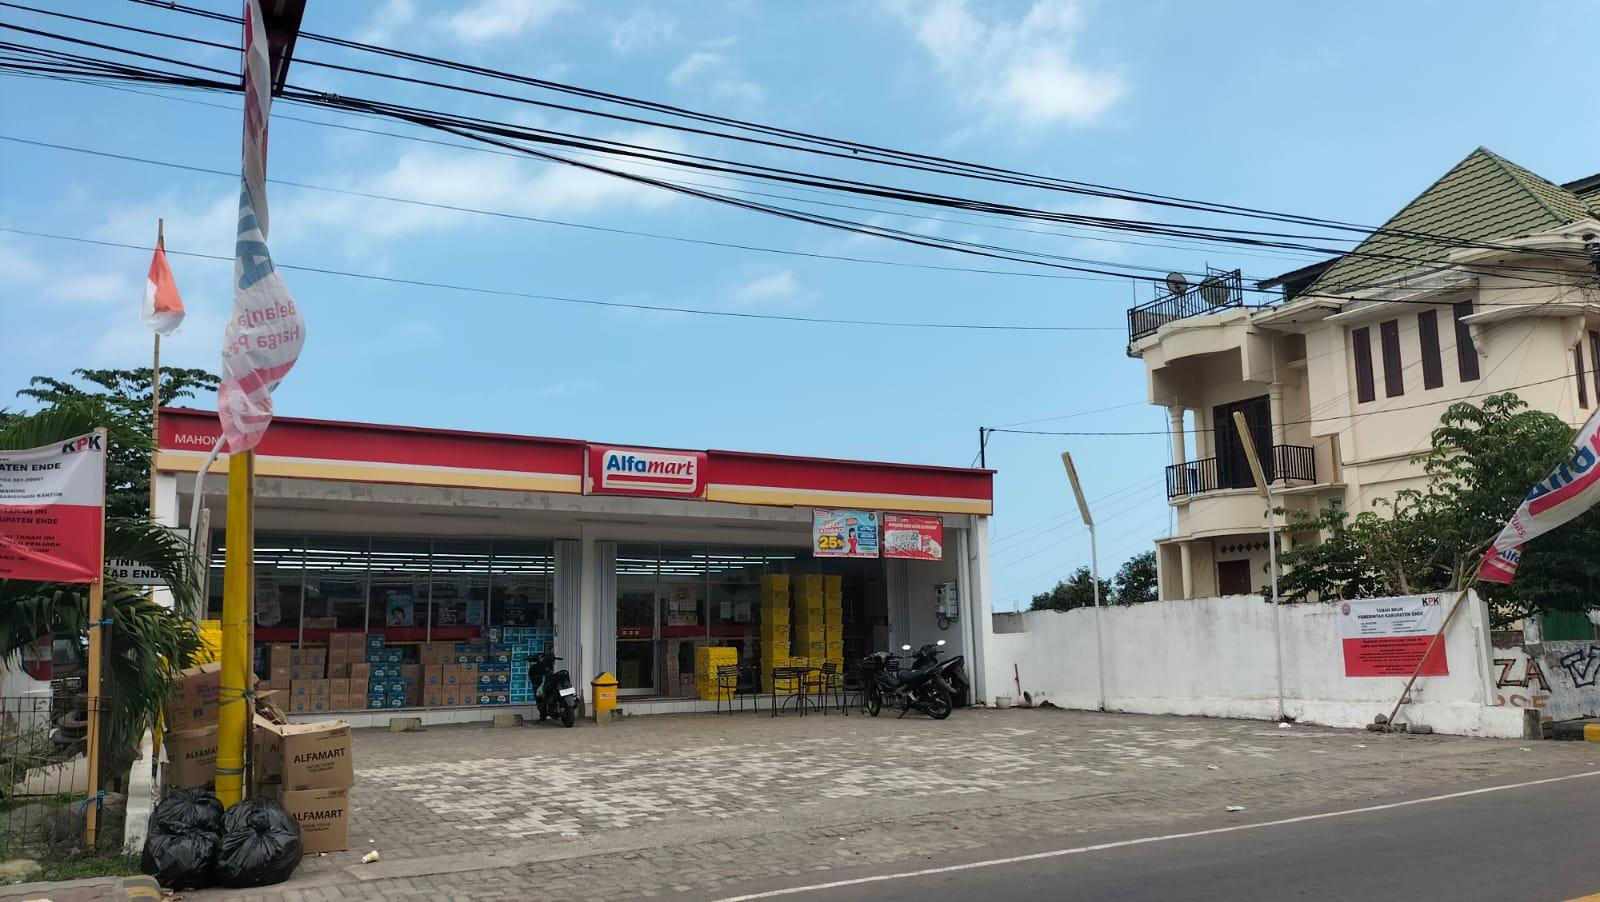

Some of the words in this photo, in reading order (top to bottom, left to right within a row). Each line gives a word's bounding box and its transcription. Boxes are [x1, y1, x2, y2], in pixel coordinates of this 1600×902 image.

[62, 435, 102, 455] KPK
[32, 462, 62, 471] ENDE
[607, 454, 694, 475] Alfamart
[35, 517, 59, 525] ENDE
[818, 534, 845, 550] 25%
[1422, 596, 1440, 607] KPK
[294, 747, 346, 764] ALFAMART
